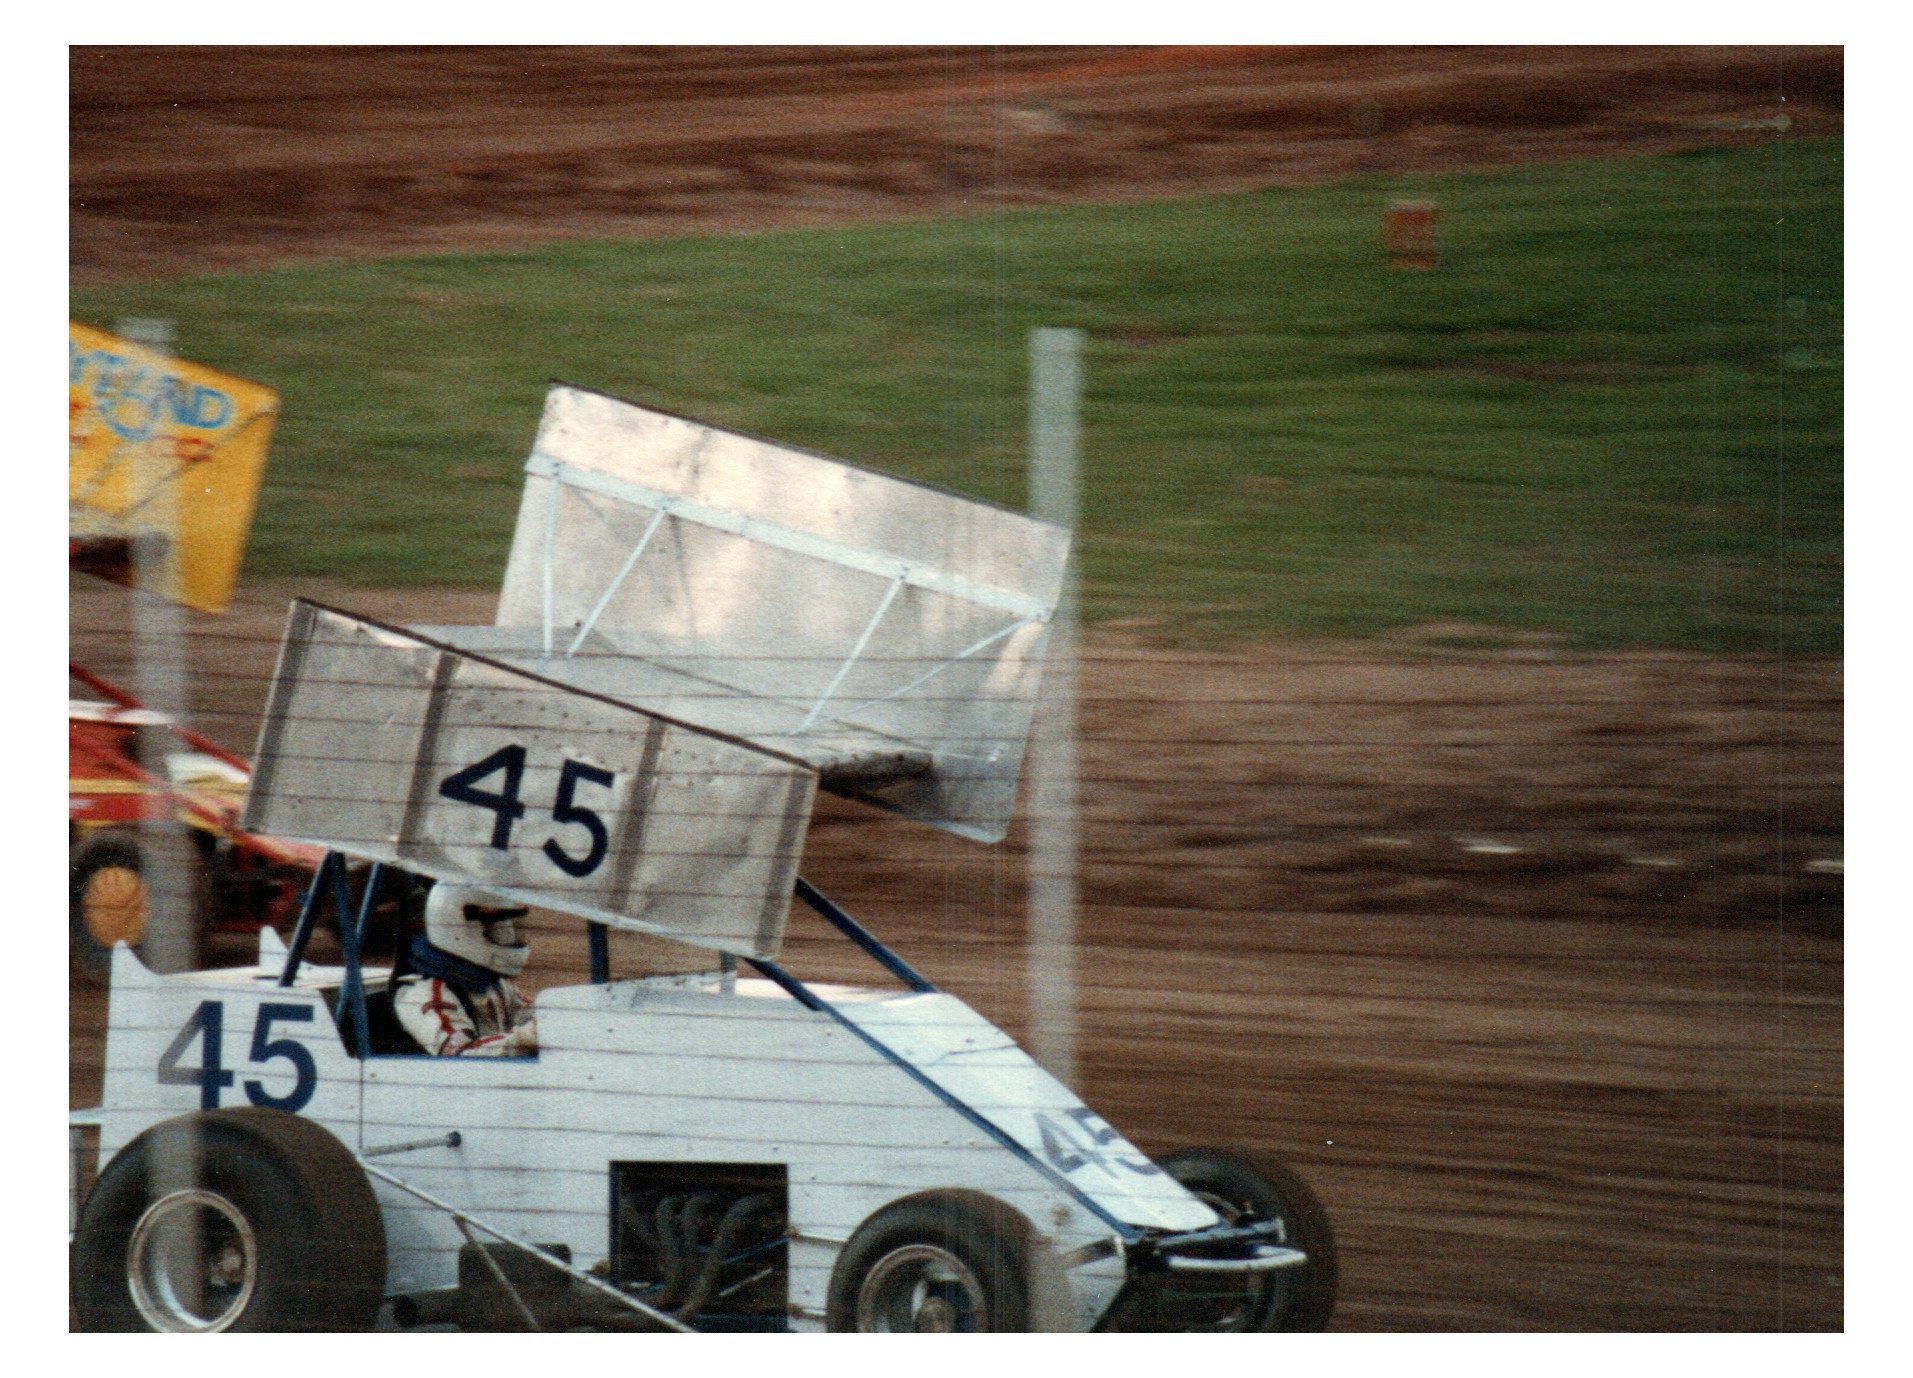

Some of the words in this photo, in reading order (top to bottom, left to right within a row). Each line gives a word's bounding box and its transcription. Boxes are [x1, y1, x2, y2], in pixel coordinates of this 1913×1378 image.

[439, 744, 615, 878] 45
[158, 1000, 317, 1113] 45
[1033, 1107, 1164, 1179] 45
